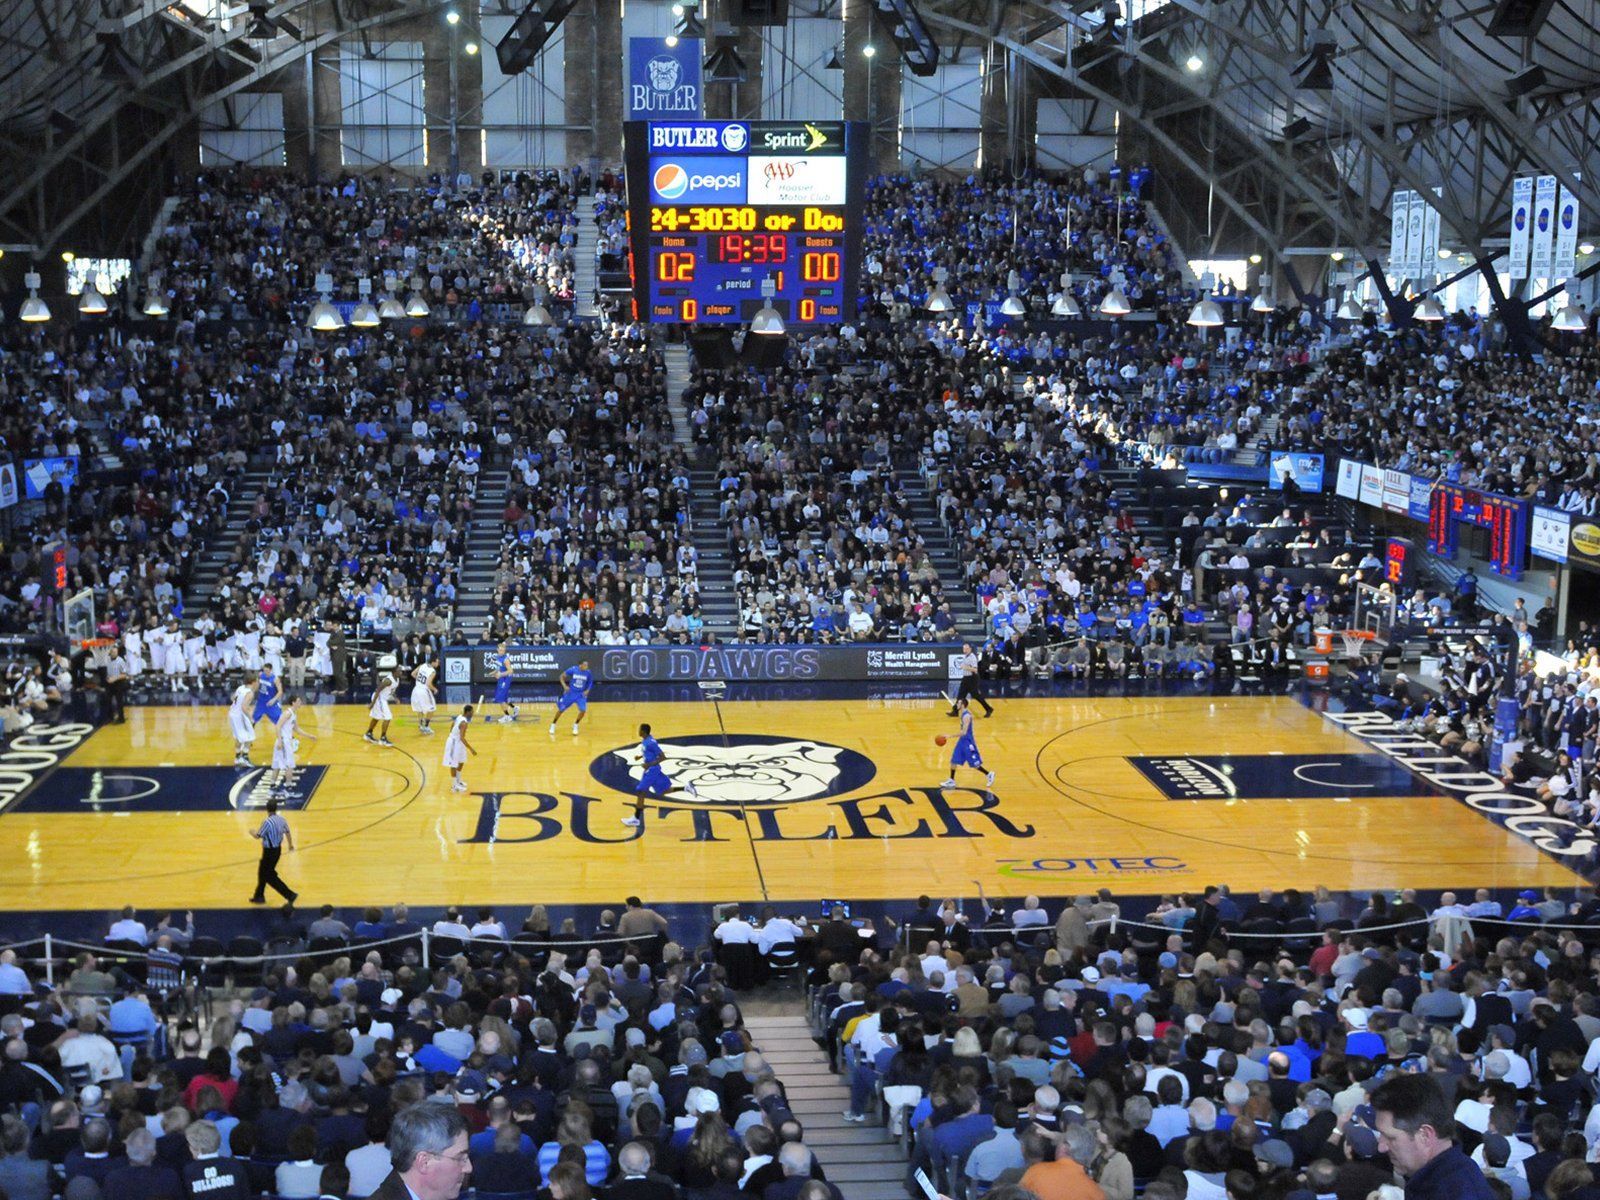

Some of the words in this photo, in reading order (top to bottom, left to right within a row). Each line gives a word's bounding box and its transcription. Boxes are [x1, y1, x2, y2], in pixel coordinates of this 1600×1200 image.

[632, 84, 697, 111] BUTLER
[652, 127, 718, 148] BUTLER
[764, 132, 807, 150] Sprint
[690, 172, 741, 191] pepsi
[779, 193, 807, 201] Motor
[810, 193, 831, 201] Club
[764, 215, 796, 231] or
[663, 237, 685, 247] Home
[719, 235, 787, 263] 19:39
[806, 237, 833, 247] Guests
[659, 252, 695, 282] 02
[804, 252, 840, 282] 00
[725, 279, 751, 290] period
[683, 299, 697, 321] 0
[706, 305, 732, 316] player
[801, 299, 815, 321] 0
[530, 652, 554, 663] Lynch
[602, 649, 657, 680] GO
[669, 649, 820, 680] DAWGS
[884, 651, 911, 660] Merrill
[912, 651, 936, 661] Lynch
[417, 672, 427, 685] 20
[1322, 711, 1599, 855] BULLDOGS
[457, 787, 1036, 845] BUTLER
